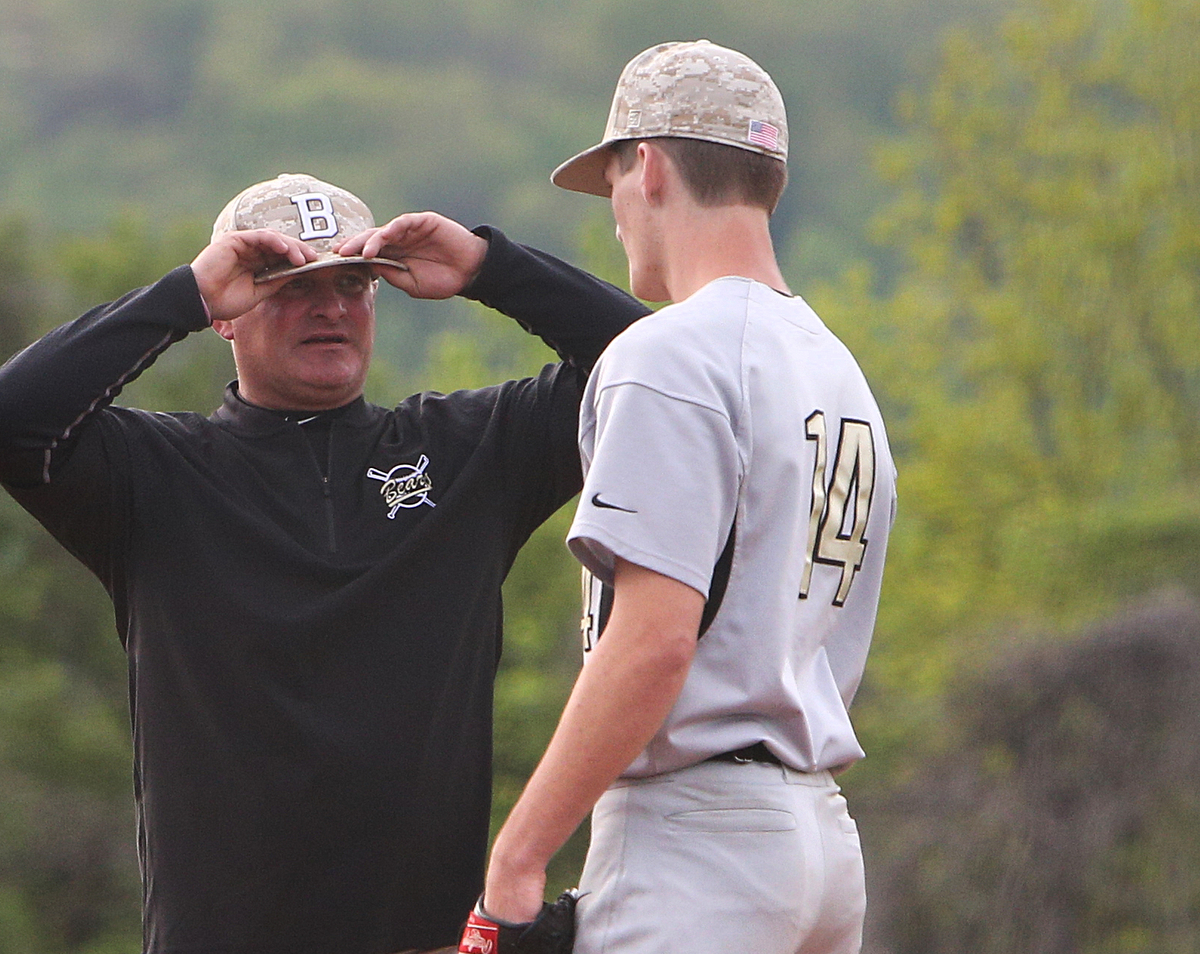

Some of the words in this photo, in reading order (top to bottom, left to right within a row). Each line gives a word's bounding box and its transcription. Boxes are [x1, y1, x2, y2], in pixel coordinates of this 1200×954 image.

[290, 192, 339, 241] B
[380, 472, 433, 507] Bears
[798, 409, 876, 607] 14
